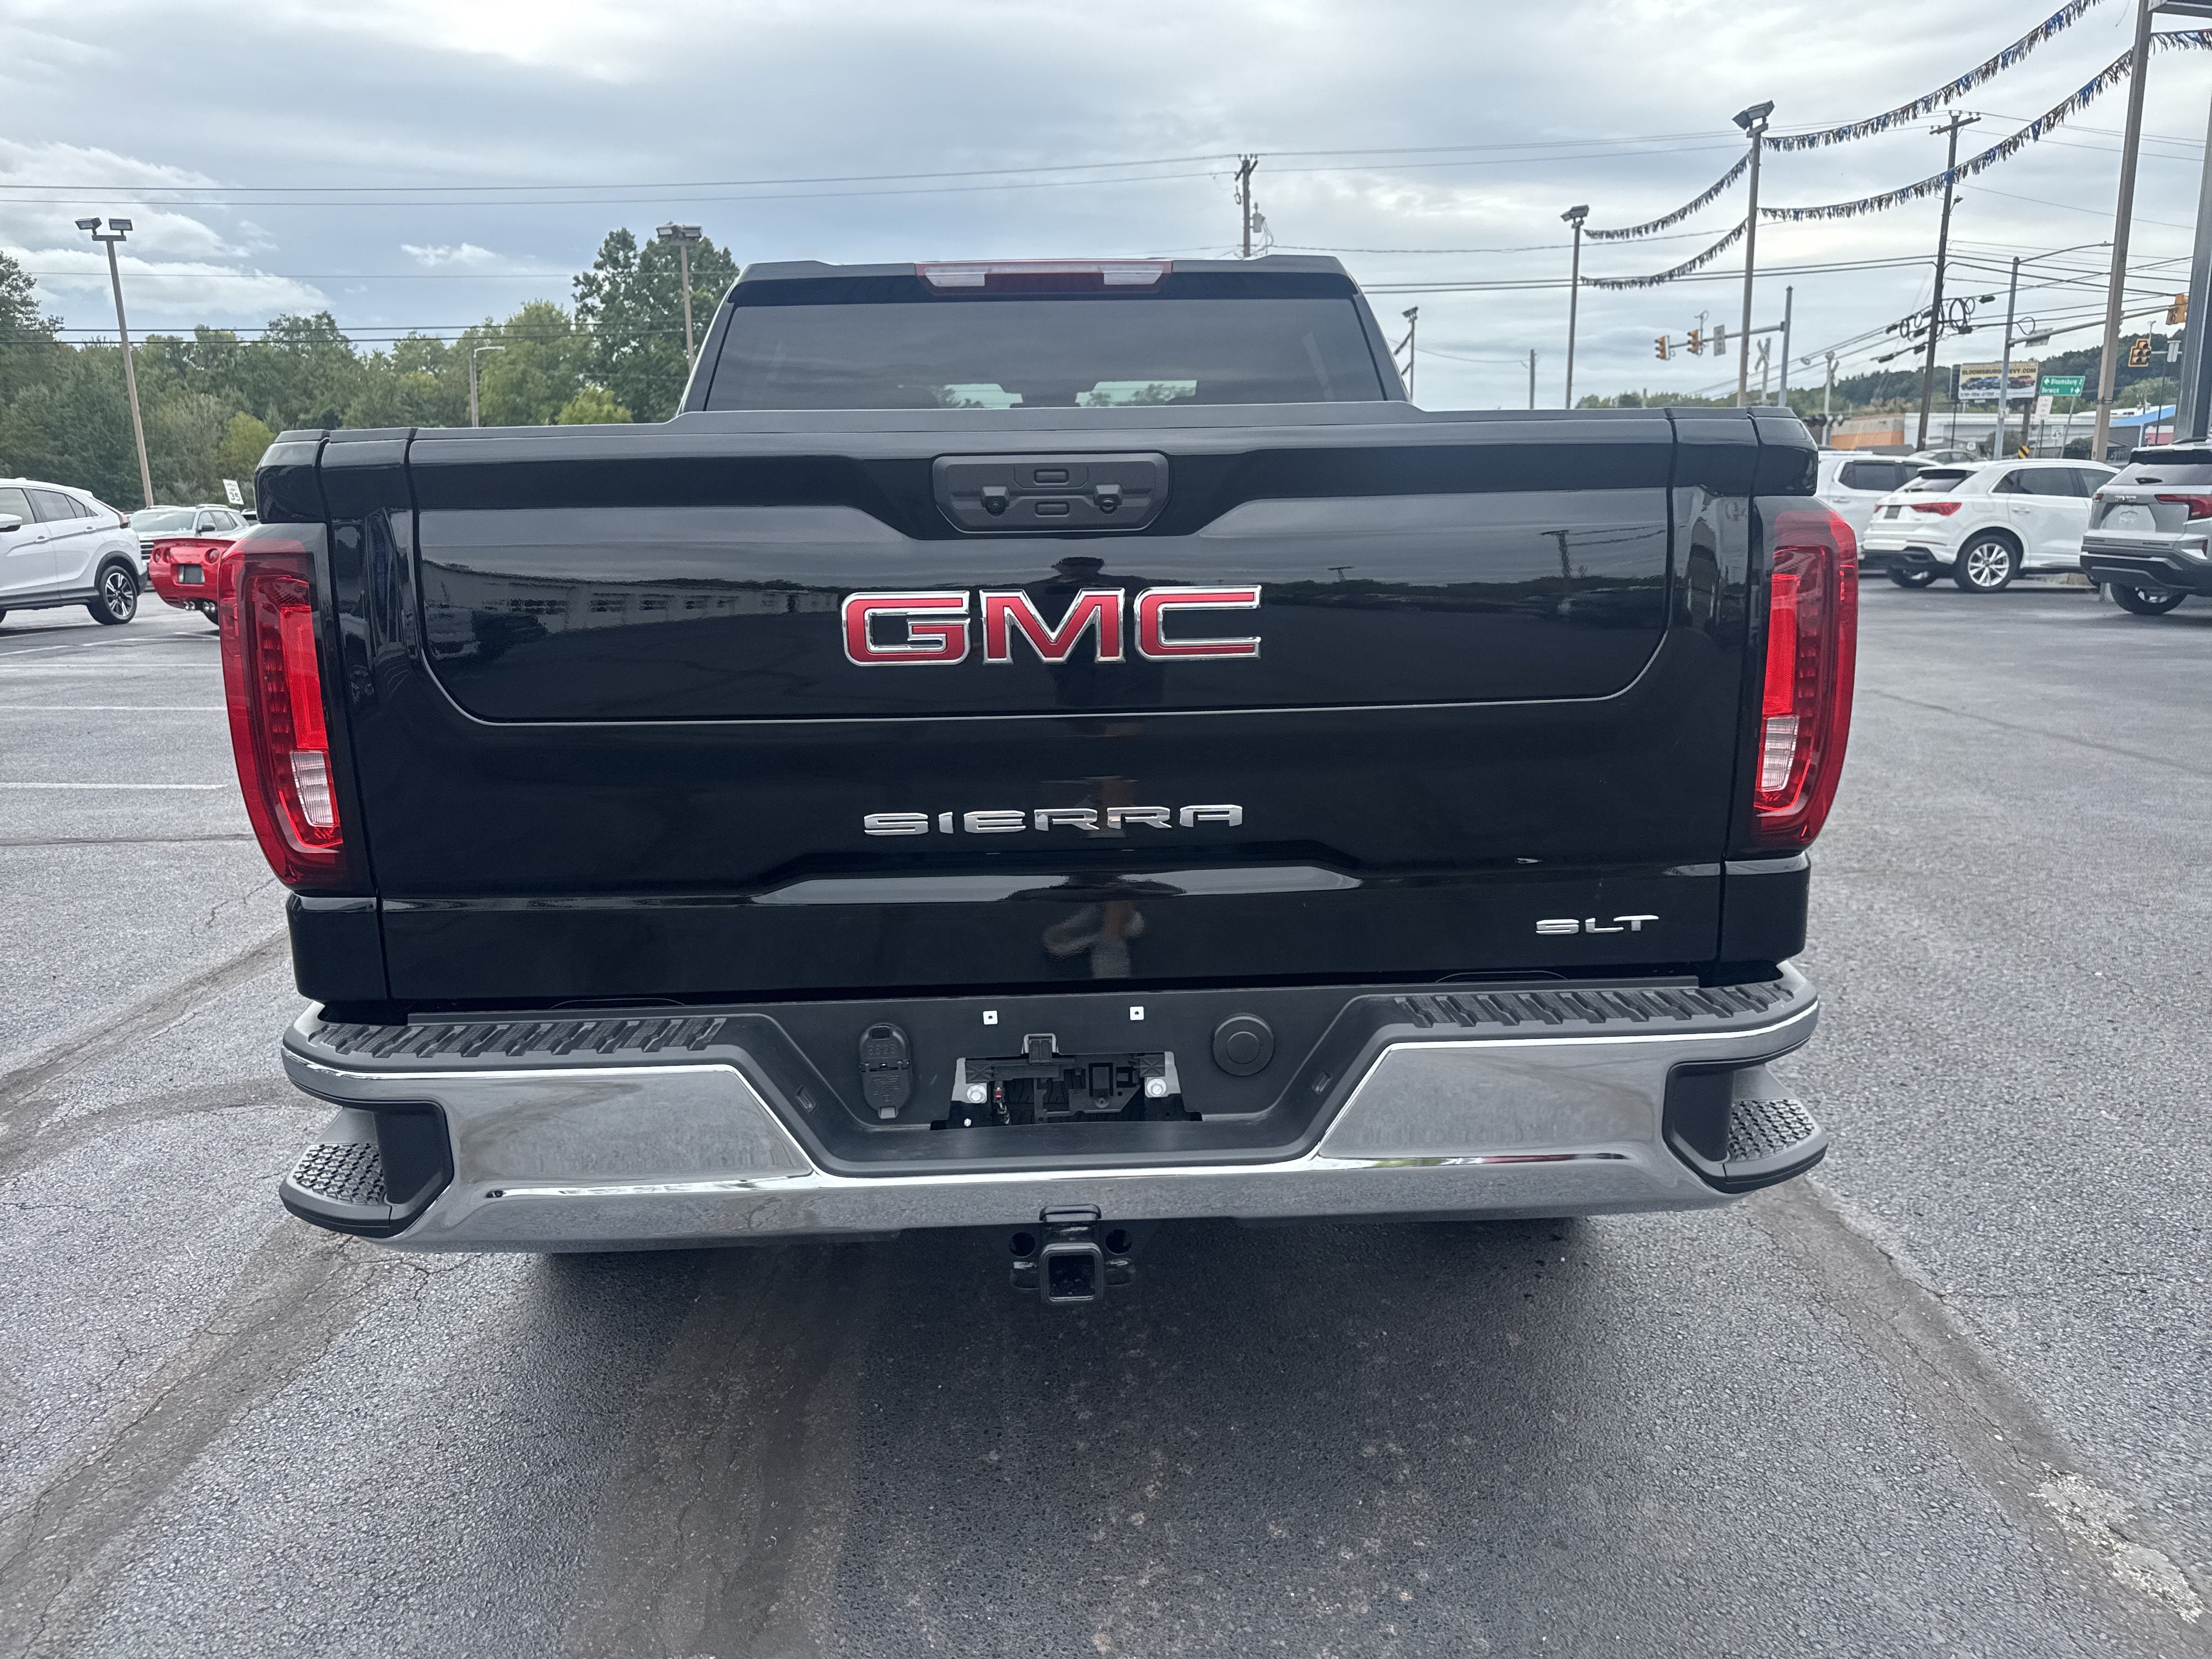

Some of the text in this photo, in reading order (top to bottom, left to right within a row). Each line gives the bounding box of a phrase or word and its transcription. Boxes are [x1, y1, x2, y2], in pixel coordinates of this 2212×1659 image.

[229, 492, 240, 501] 35
[841, 584, 1262, 666] GMC
[864, 804, 1243, 836] SIERRA
[1536, 915, 1659, 935] SLT
